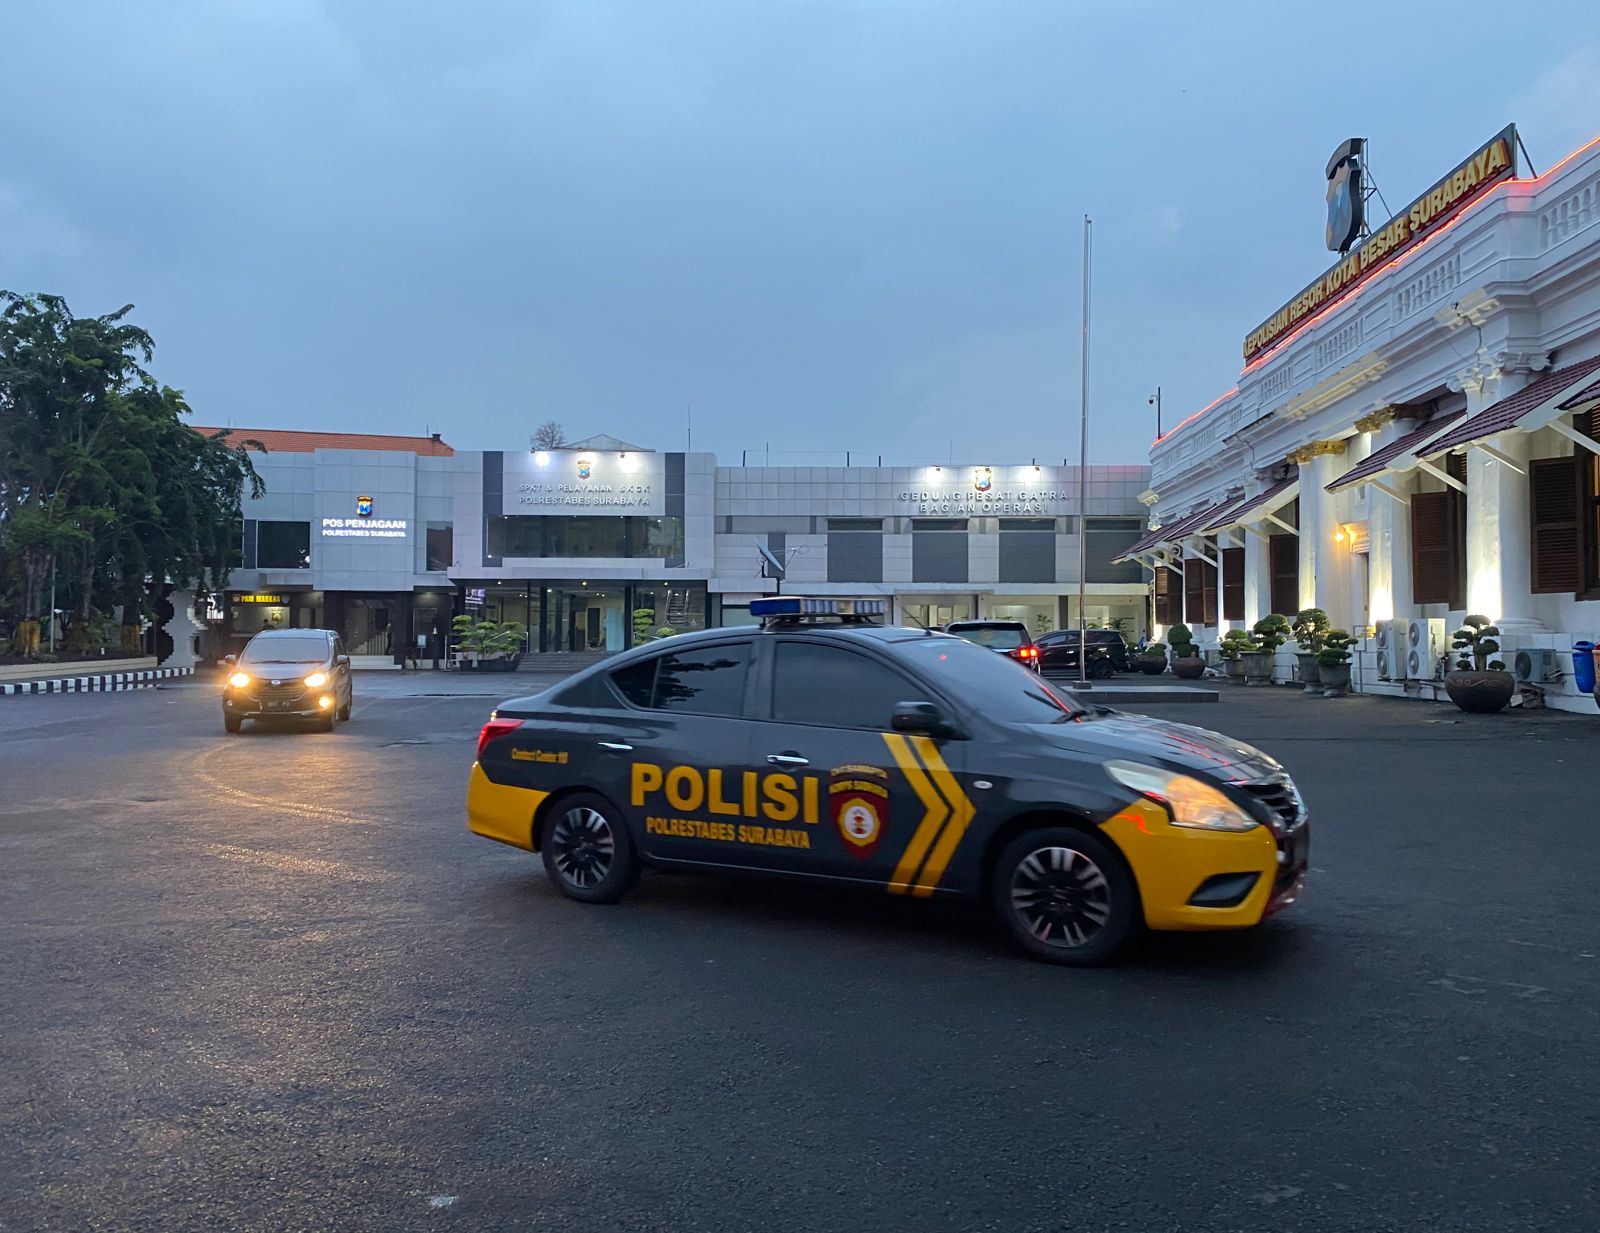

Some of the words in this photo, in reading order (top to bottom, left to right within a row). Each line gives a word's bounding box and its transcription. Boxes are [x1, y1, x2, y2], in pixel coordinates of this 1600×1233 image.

[1243, 307, 1290, 357] KEPOLISIAN
[1290, 281, 1324, 322] RESOR
[1326, 255, 1359, 294] KOTA
[1360, 217, 1408, 270] BESAR
[1409, 140, 1507, 232] SURABAYA
[520, 483, 543, 493] SPKT
[558, 483, 613, 493] PELAYANAN
[520, 496, 591, 506] POLRESTABES
[593, 497, 650, 507] SURABAYA
[901, 491, 961, 502] GEDUNG
[1019, 491, 1069, 501] GATRA
[919, 503, 976, 514] BAGIAN
[982, 503, 1049, 514] OPERASI
[322, 518, 343, 528] POS
[345, 519, 406, 529] PENJAGAAN
[322, 529, 370, 537] POLRESTABES
[370, 530, 406, 538] SURABAYA
[631, 762, 819, 824] POLISI
[646, 816, 735, 841] POLRESTABES
[738, 824, 811, 849] SURABAYA
